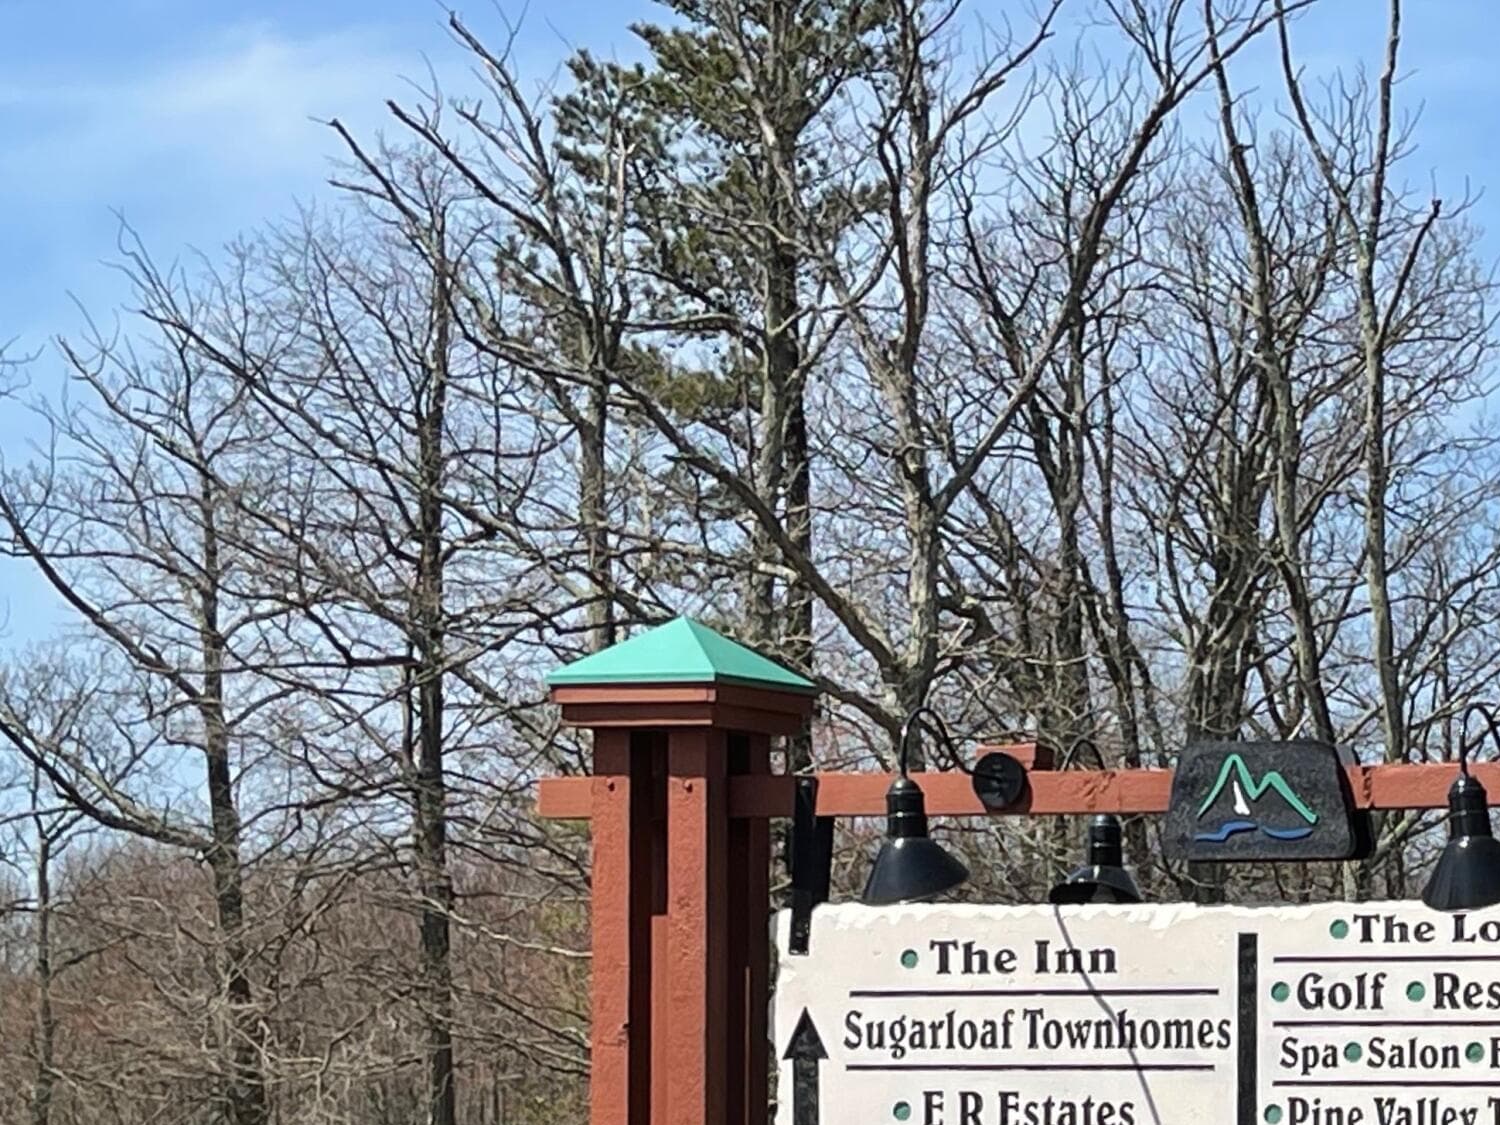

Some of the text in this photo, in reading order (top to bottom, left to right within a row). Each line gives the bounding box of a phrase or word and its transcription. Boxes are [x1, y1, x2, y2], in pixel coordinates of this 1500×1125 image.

[1353, 914, 1436, 944] The
[930, 938, 1118, 976] The Inn
[1297, 972, 1387, 1010] Golf
[843, 1009, 1232, 1059] Sugarloaf Townhomes
[1280, 1037, 1339, 1075] Spa
[1367, 1037, 1461, 1069] Salon
